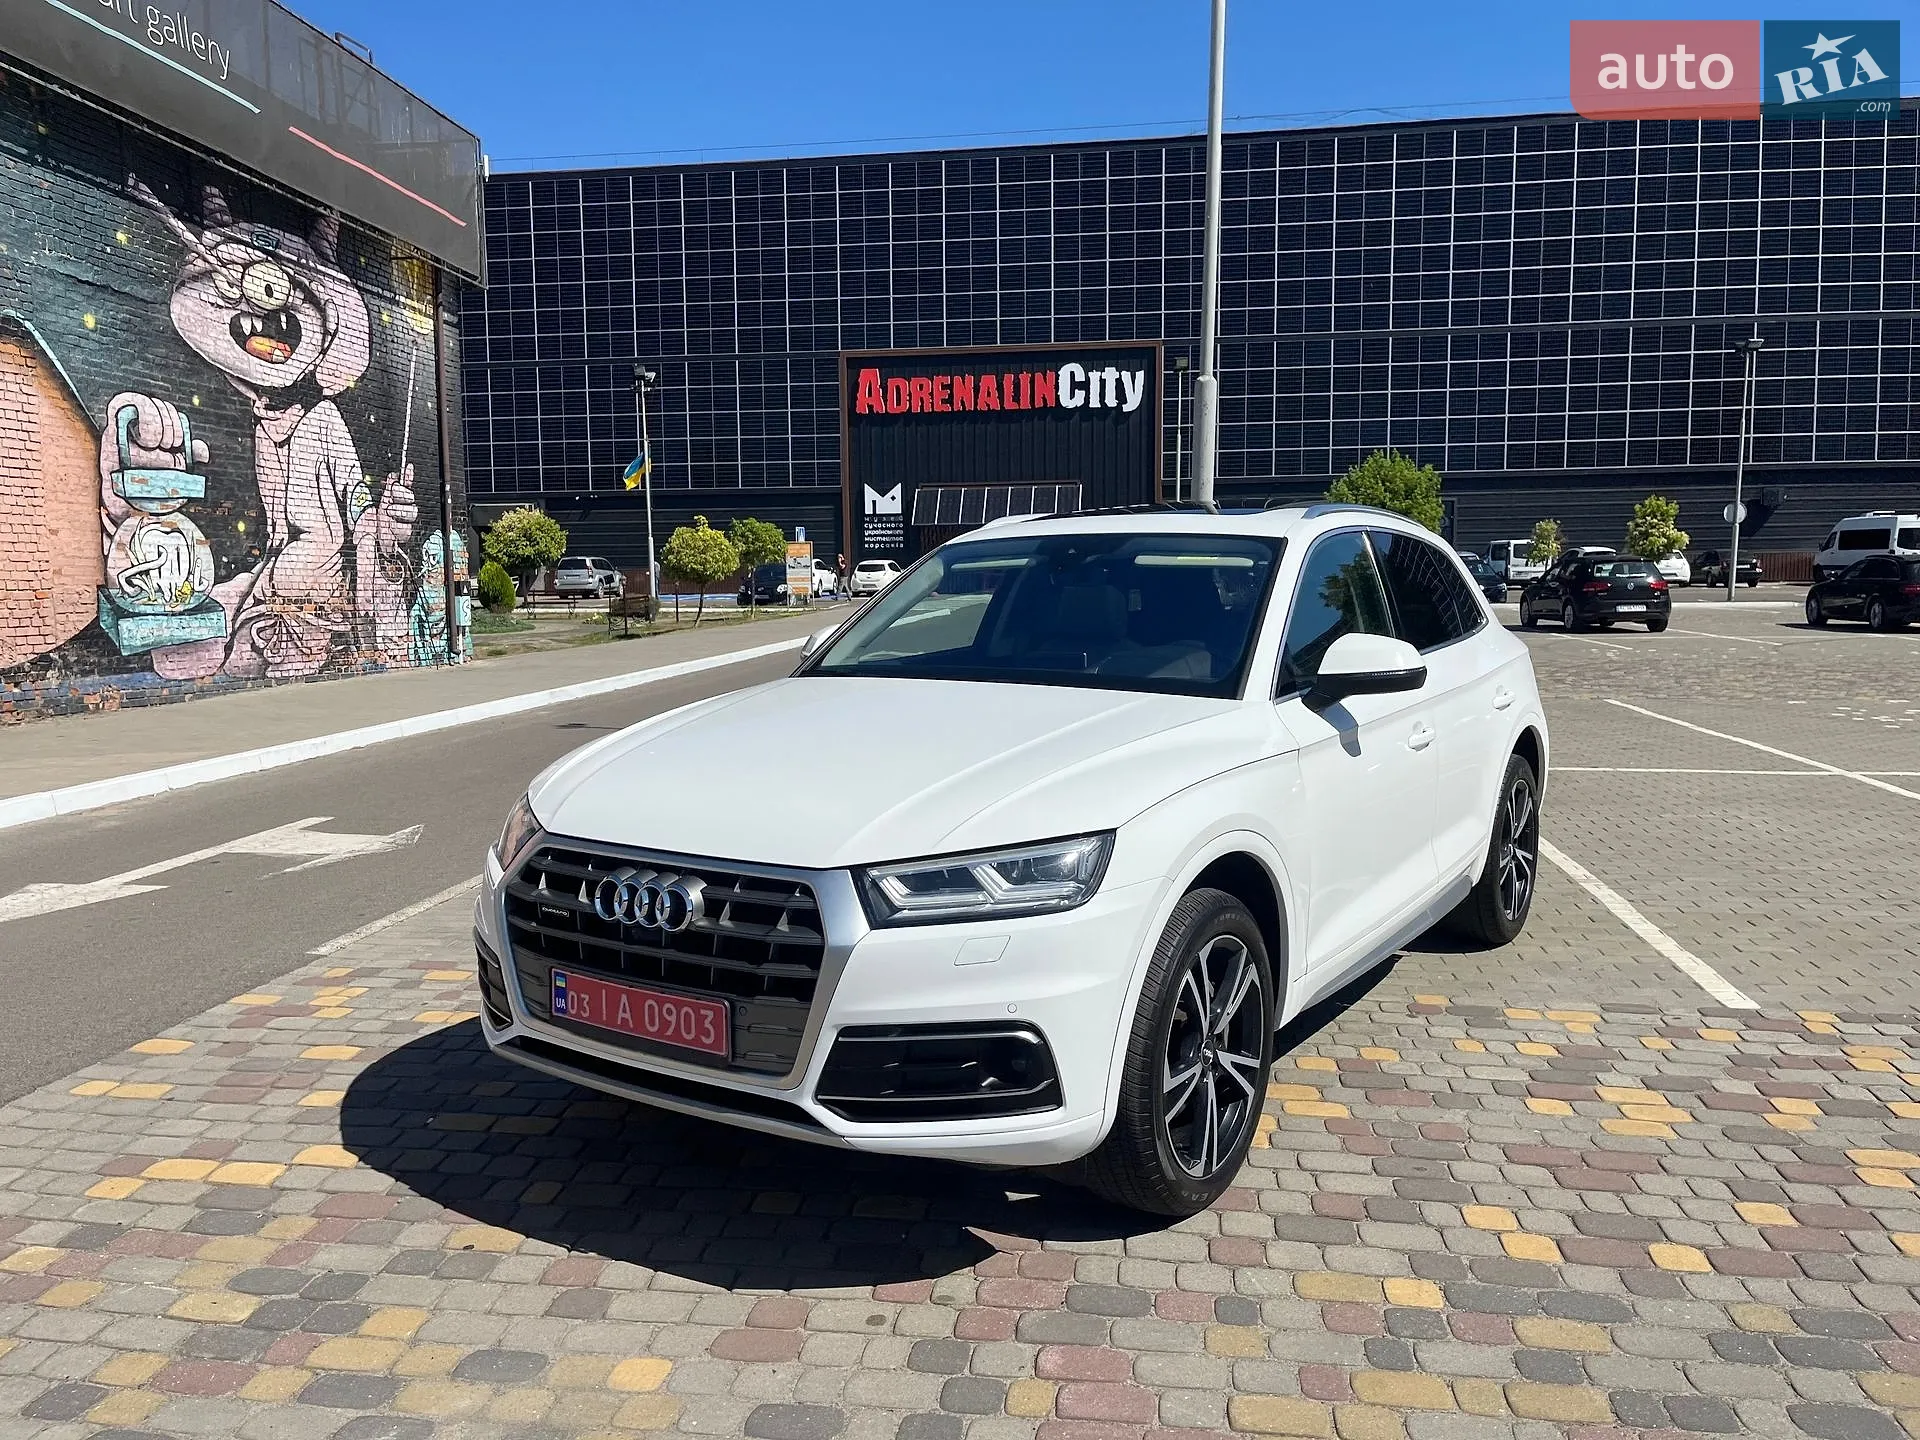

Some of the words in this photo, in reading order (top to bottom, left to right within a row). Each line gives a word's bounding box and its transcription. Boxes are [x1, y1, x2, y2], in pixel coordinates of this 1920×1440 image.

[146, 5, 230, 80] gallery
[555, 997, 567, 1010] UA
[568, 990, 590, 1018] 03
[644, 999, 715, 1045] 0903
